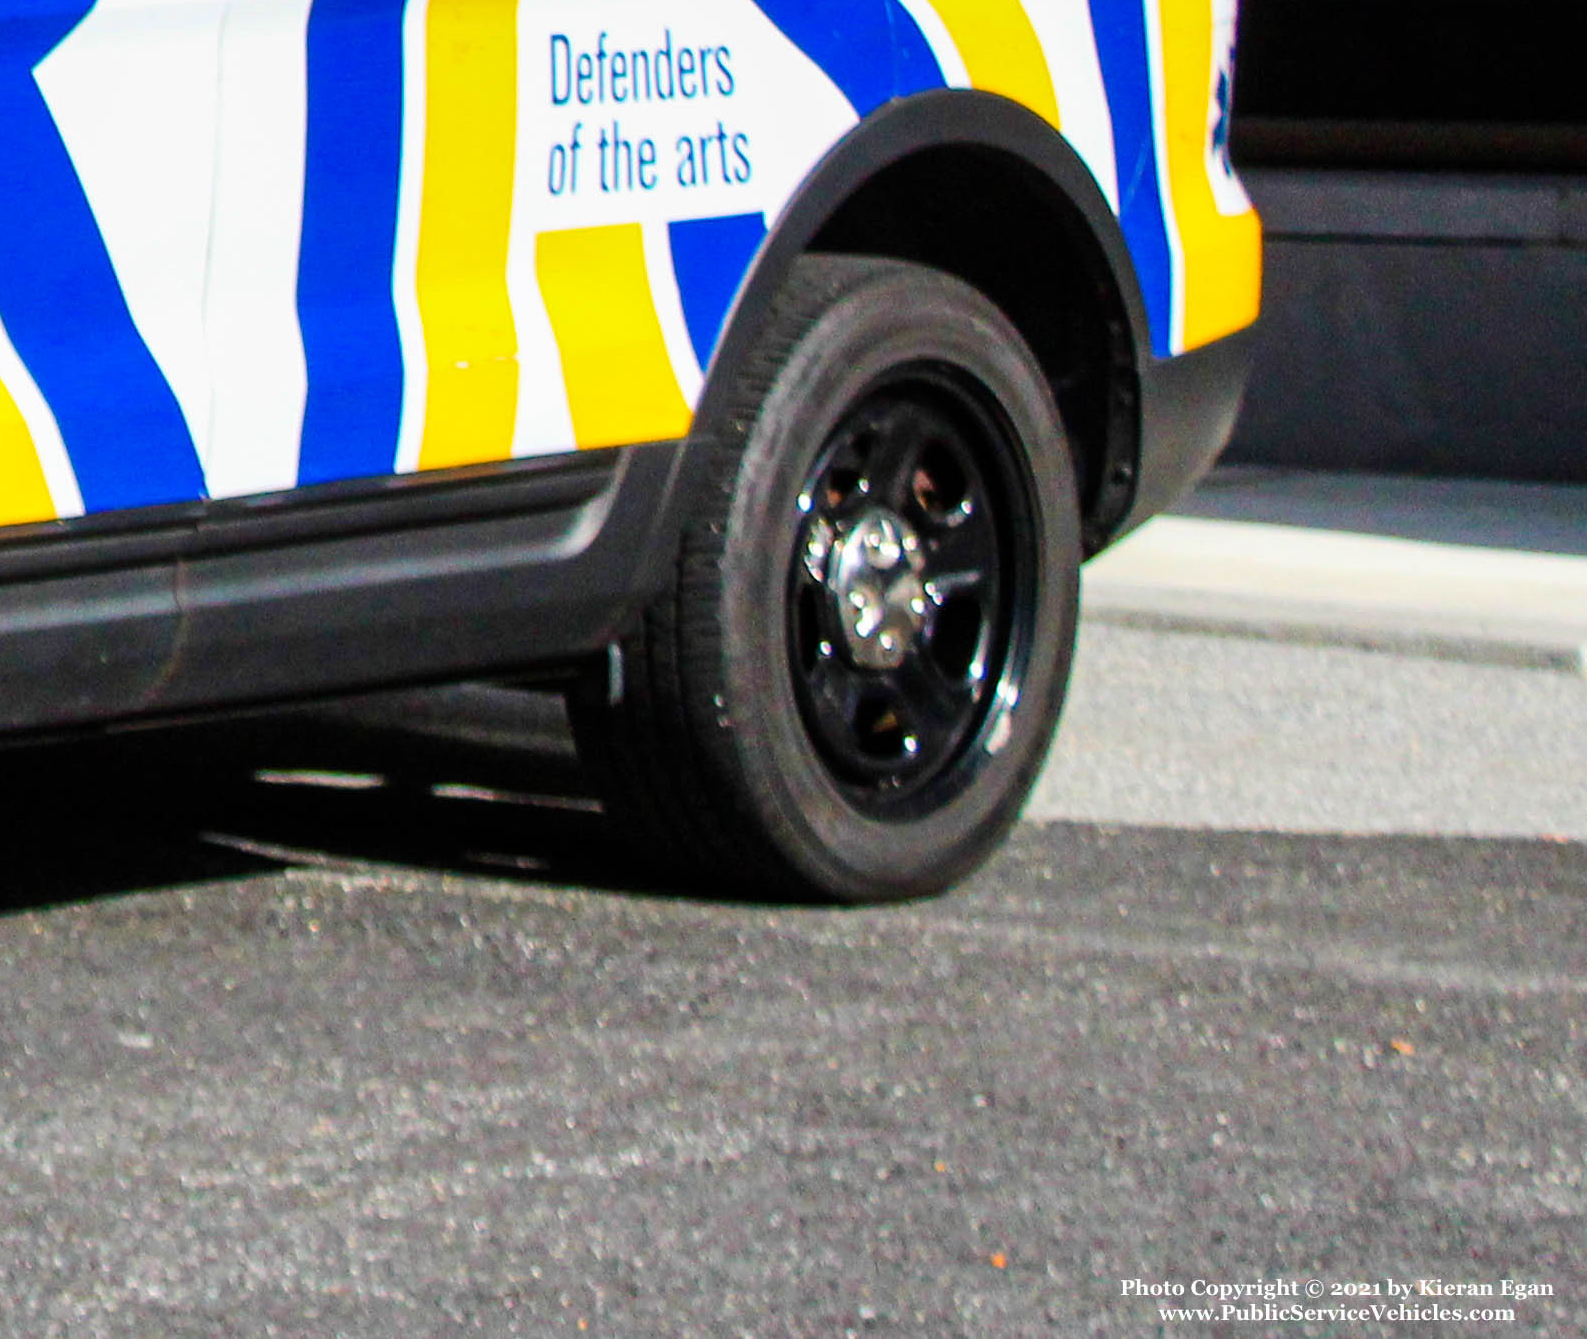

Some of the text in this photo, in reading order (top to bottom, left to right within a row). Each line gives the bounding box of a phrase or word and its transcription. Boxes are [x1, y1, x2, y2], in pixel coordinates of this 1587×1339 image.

[550, 29, 735, 106] Defenders
[548, 120, 752, 196] of the arts
